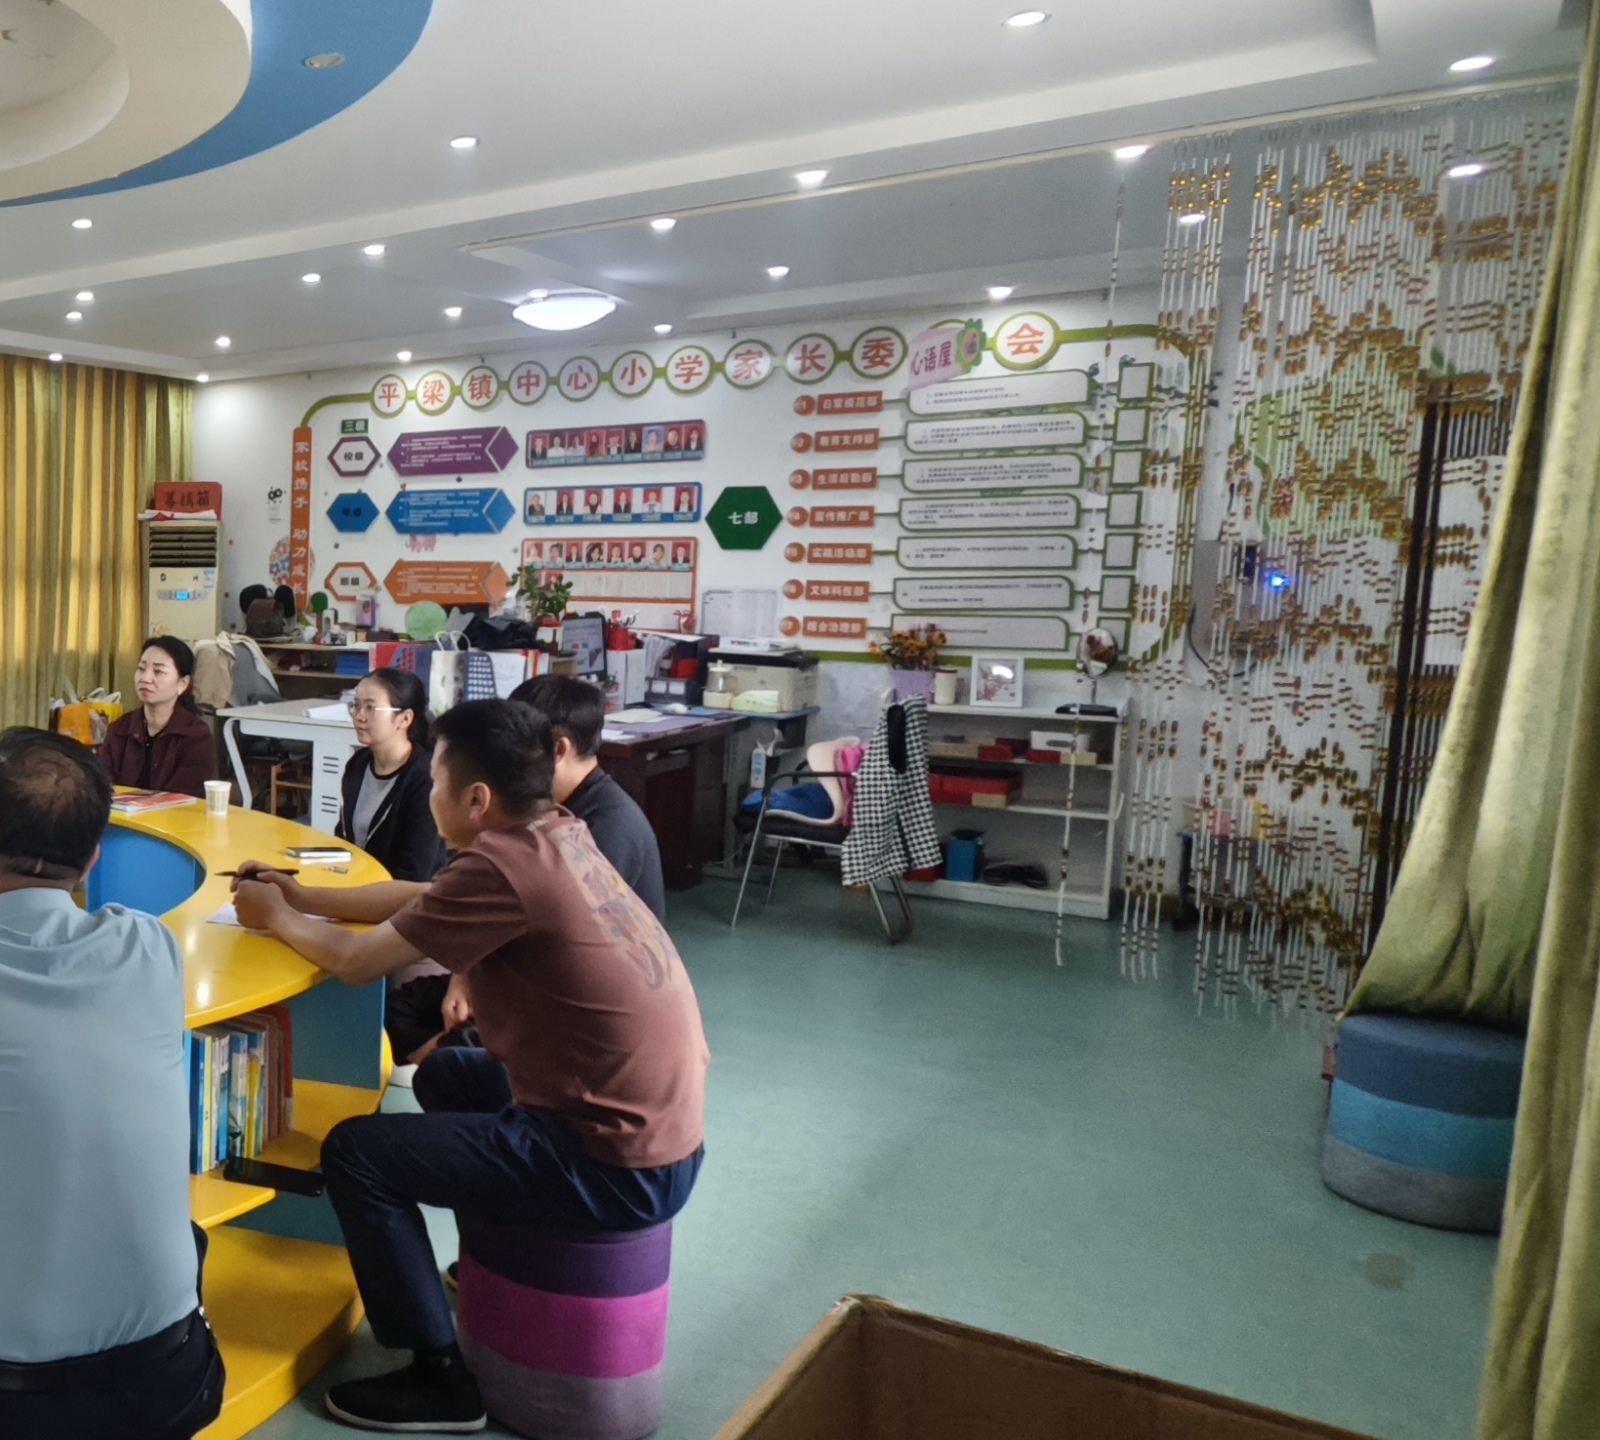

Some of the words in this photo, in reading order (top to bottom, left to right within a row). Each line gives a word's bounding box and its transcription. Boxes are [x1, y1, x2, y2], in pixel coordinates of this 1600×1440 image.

[380, 322, 1045, 408] 平梁镇中心小学家长委会
[910, 340, 953, 377] 心语屋
[293, 441, 310, 509] 家校携手
[343, 451, 364, 462] 校级
[727, 511, 760, 527] 七部
[291, 527, 308, 596] 助力成长
